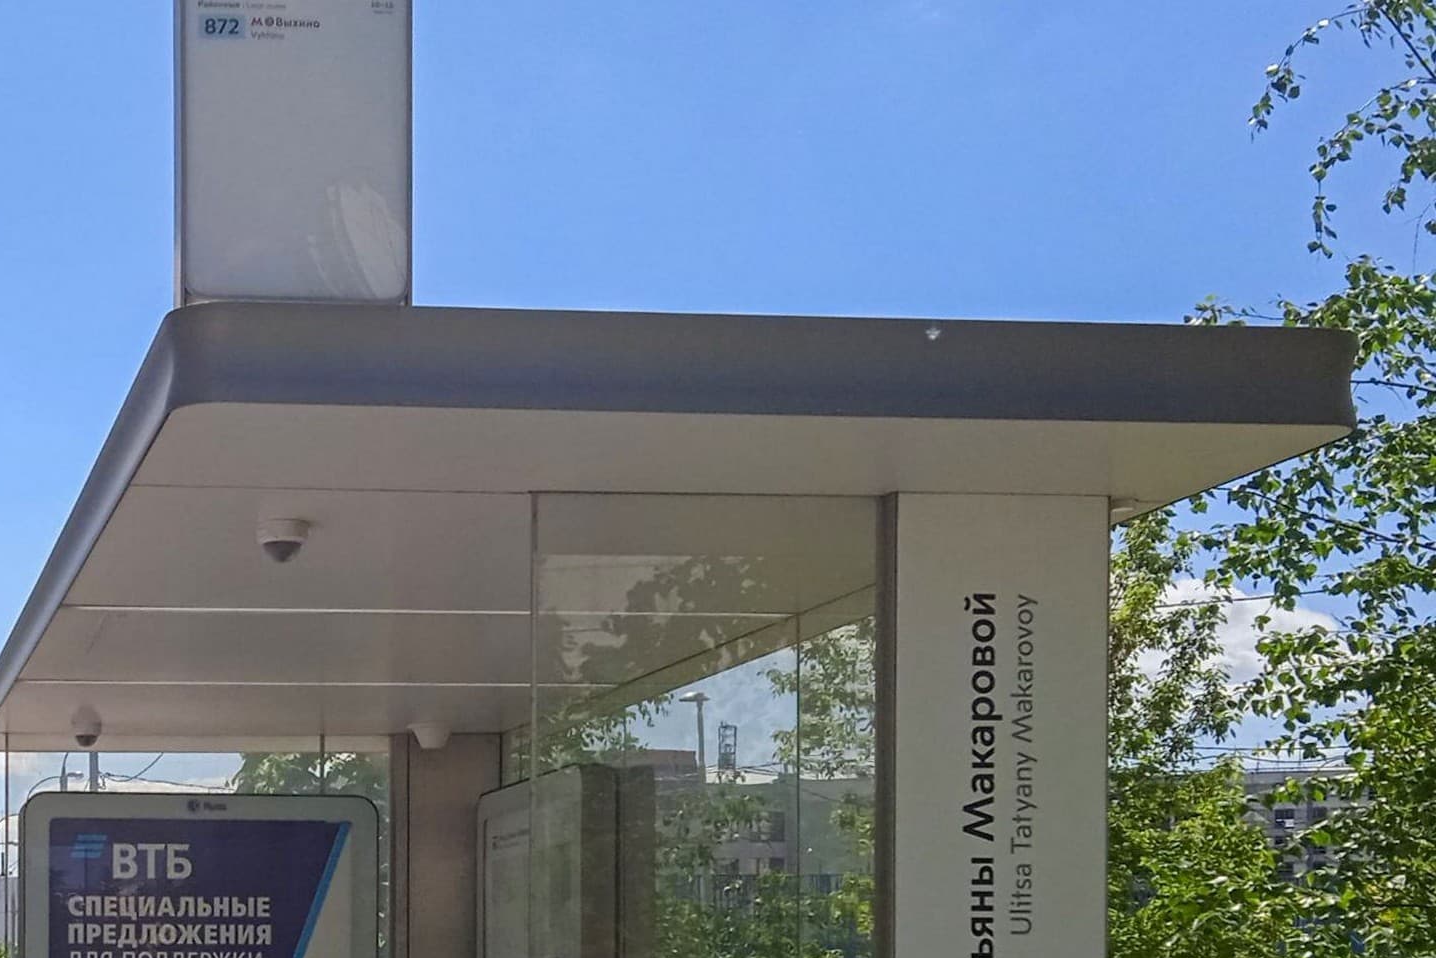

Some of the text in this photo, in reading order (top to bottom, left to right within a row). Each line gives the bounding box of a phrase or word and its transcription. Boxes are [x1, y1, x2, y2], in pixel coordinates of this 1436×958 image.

[204, 17, 240, 35] 872
[275, 17, 321, 29] Выхино
[962, 592, 1003, 843] Макаровой
[1010, 593, 1039, 936] Ulitsa Tatyany Makarovoy
[112, 843, 193, 880] ВТБ
[67, 896, 271, 921] СПЕЦИАЛЬНЫЕ
[67, 923, 272, 949] ПРЕДЛОЖЕНИЯ
